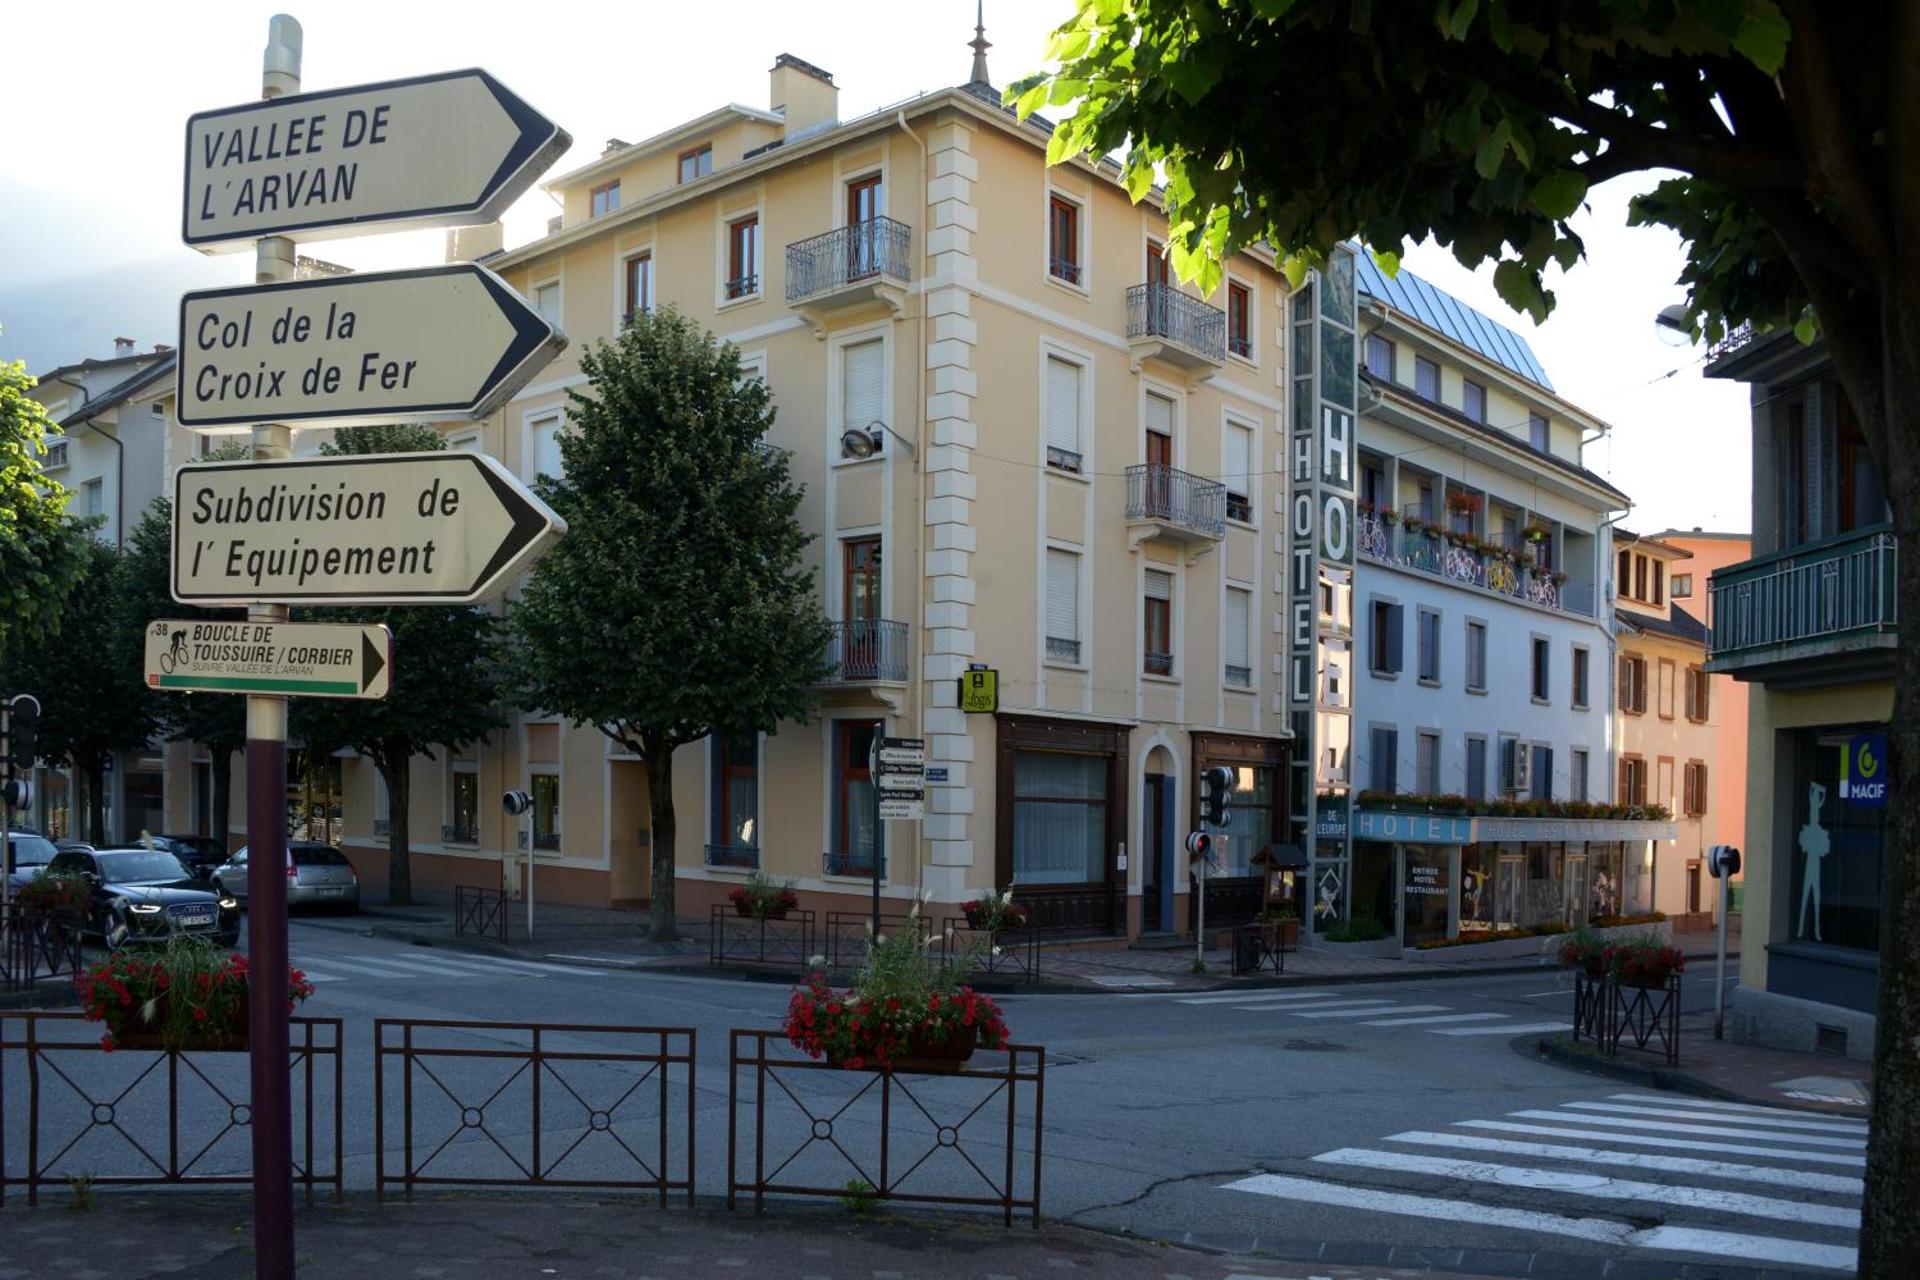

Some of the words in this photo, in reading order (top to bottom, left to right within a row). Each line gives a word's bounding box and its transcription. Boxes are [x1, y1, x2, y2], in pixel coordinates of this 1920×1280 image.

[205, 114, 326, 169] VALLEE
[342, 104, 390, 149] DE
[200, 163, 358, 220] L'ARVAN
[197, 310, 252, 351] Col
[272, 306, 311, 345] de
[325, 302, 356, 340] la
[195, 361, 286, 402] Croix
[302, 357, 341, 396] de
[358, 352, 417, 392] Fer
[192, 482, 386, 525] Subdivision
[418, 477, 460, 518] de
[1293, 437, 1312, 700] HOTEL
[193, 624, 250, 642] BOUCLE
[253, 626, 273, 643] DE
[194, 643, 275, 663] TOUSSUIRE
[288, 647, 353, 666] CORBIER
[260, 664, 273, 674] DE
[1851, 783, 1885, 799] MACIF
[1360, 814, 1463, 841] HOTEL
